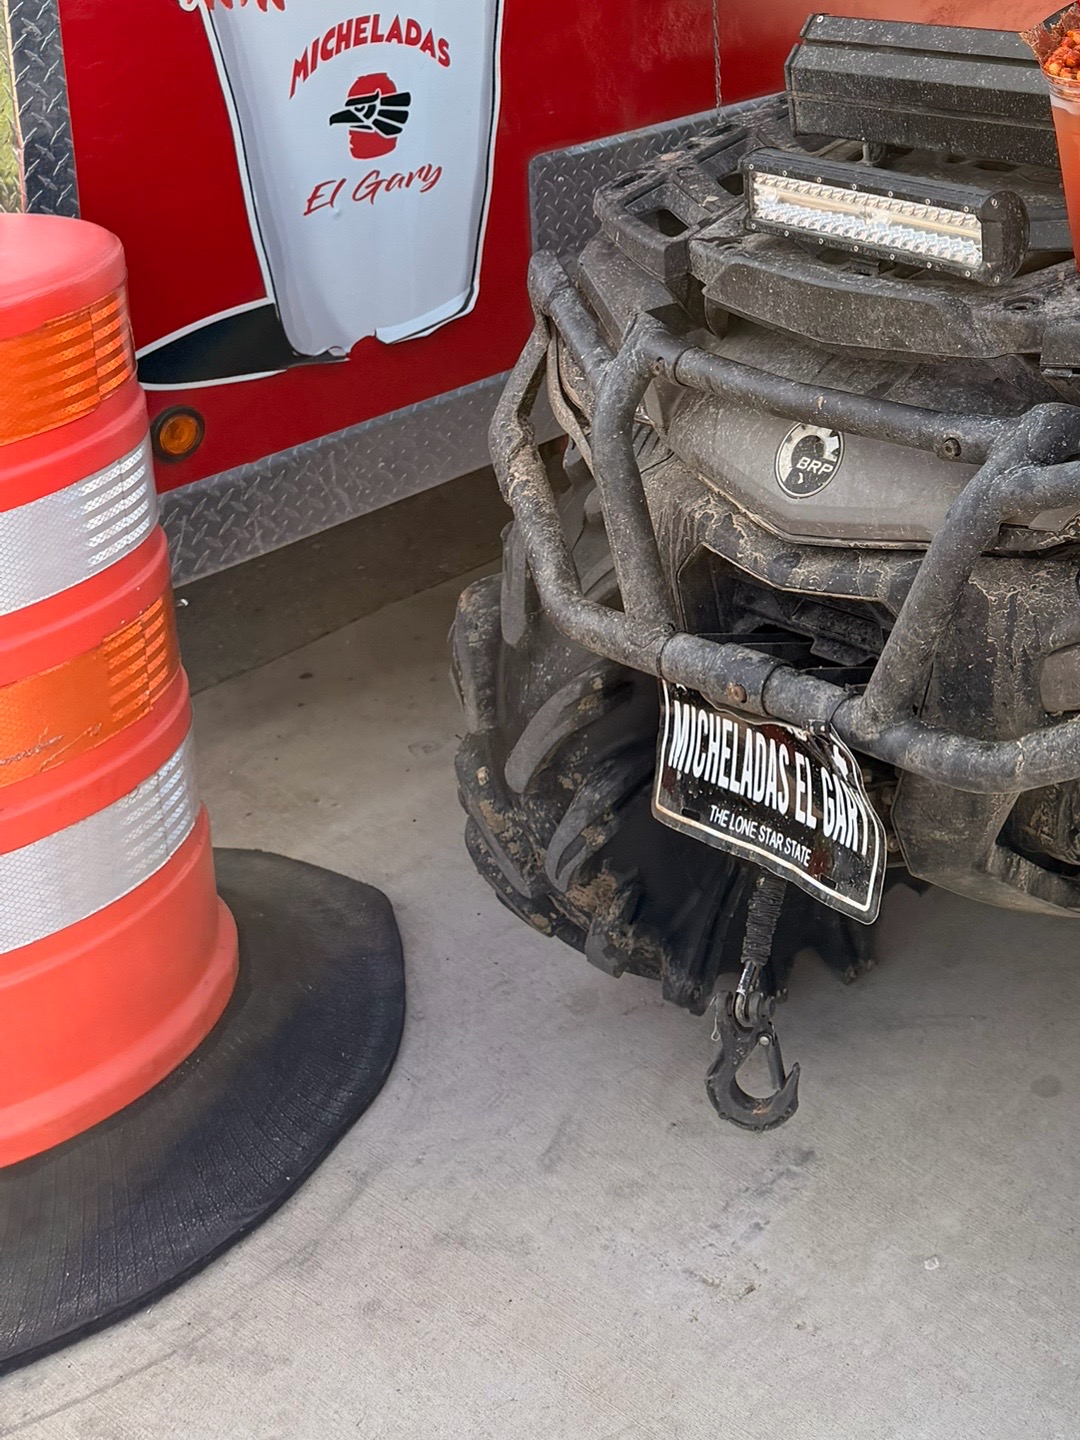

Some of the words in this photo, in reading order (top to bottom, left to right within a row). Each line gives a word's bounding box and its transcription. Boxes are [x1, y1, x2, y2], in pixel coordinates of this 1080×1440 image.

[289, 13, 451, 100] MICHELADAS
[303, 178, 346, 216] El
[352, 163, 443, 205] Gary
[796, 456, 834, 475] BRP
[668, 700, 789, 816] MICHELADAS
[795, 751, 817, 830] EL
[710, 804, 729, 828] THE
[729, 816, 758, 840] LONE
[757, 825, 782, 852] STAR
[783, 836, 812, 868] STATE
